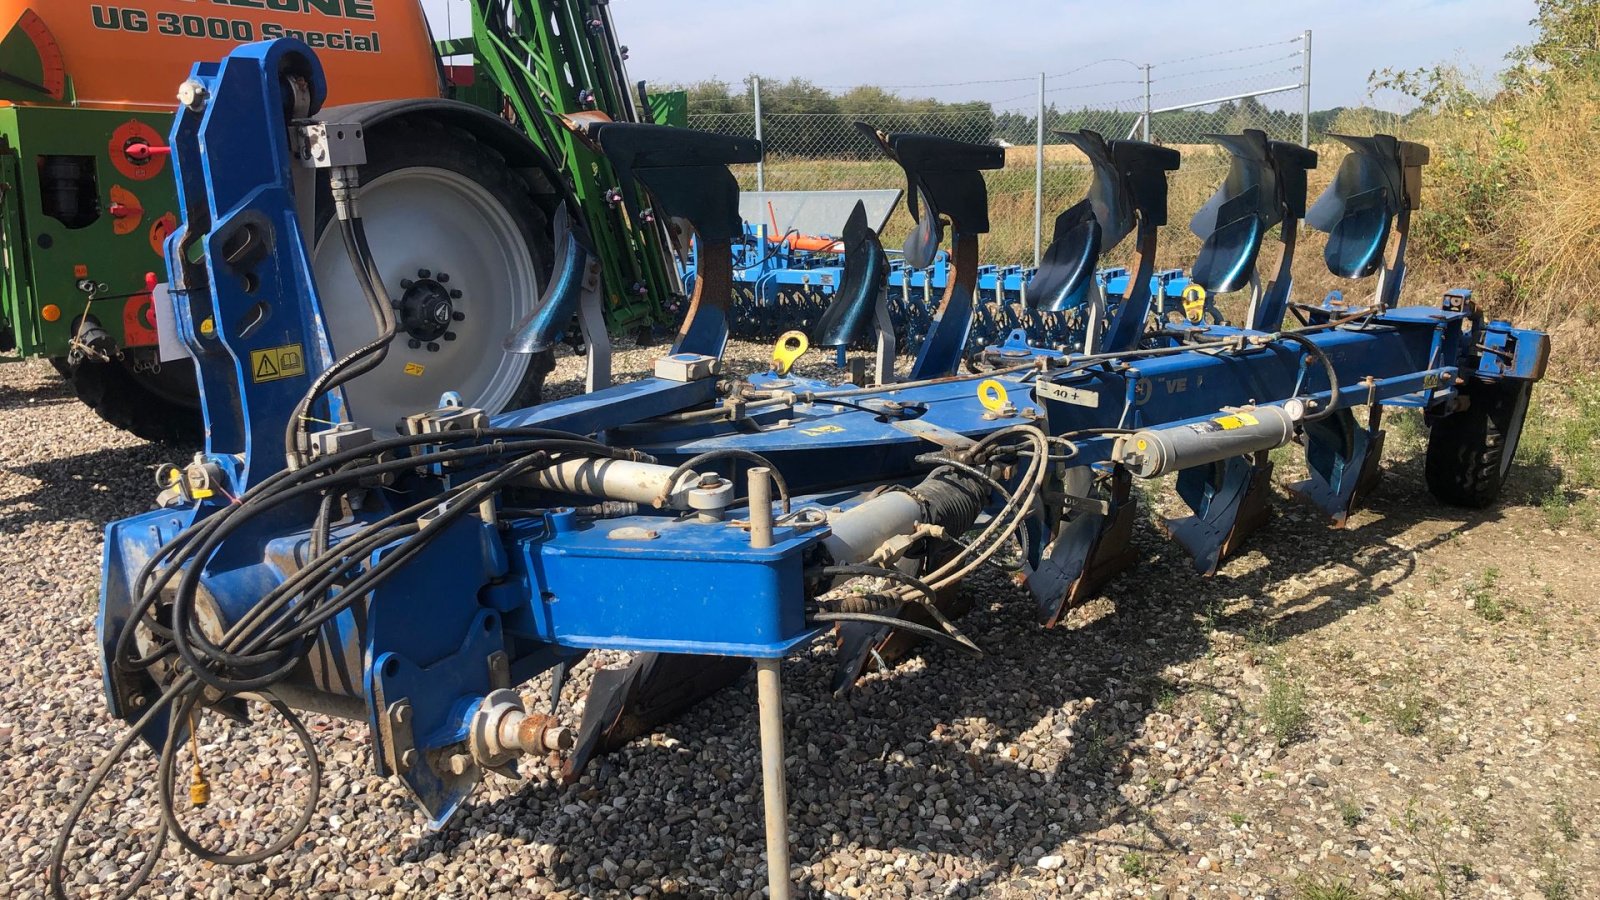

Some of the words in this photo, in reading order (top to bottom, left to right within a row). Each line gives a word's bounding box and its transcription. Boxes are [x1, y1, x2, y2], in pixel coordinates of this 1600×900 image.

[91, 5, 149, 33] UG
[156, 12, 254, 42] 3000
[261, 22, 381, 53] Special
